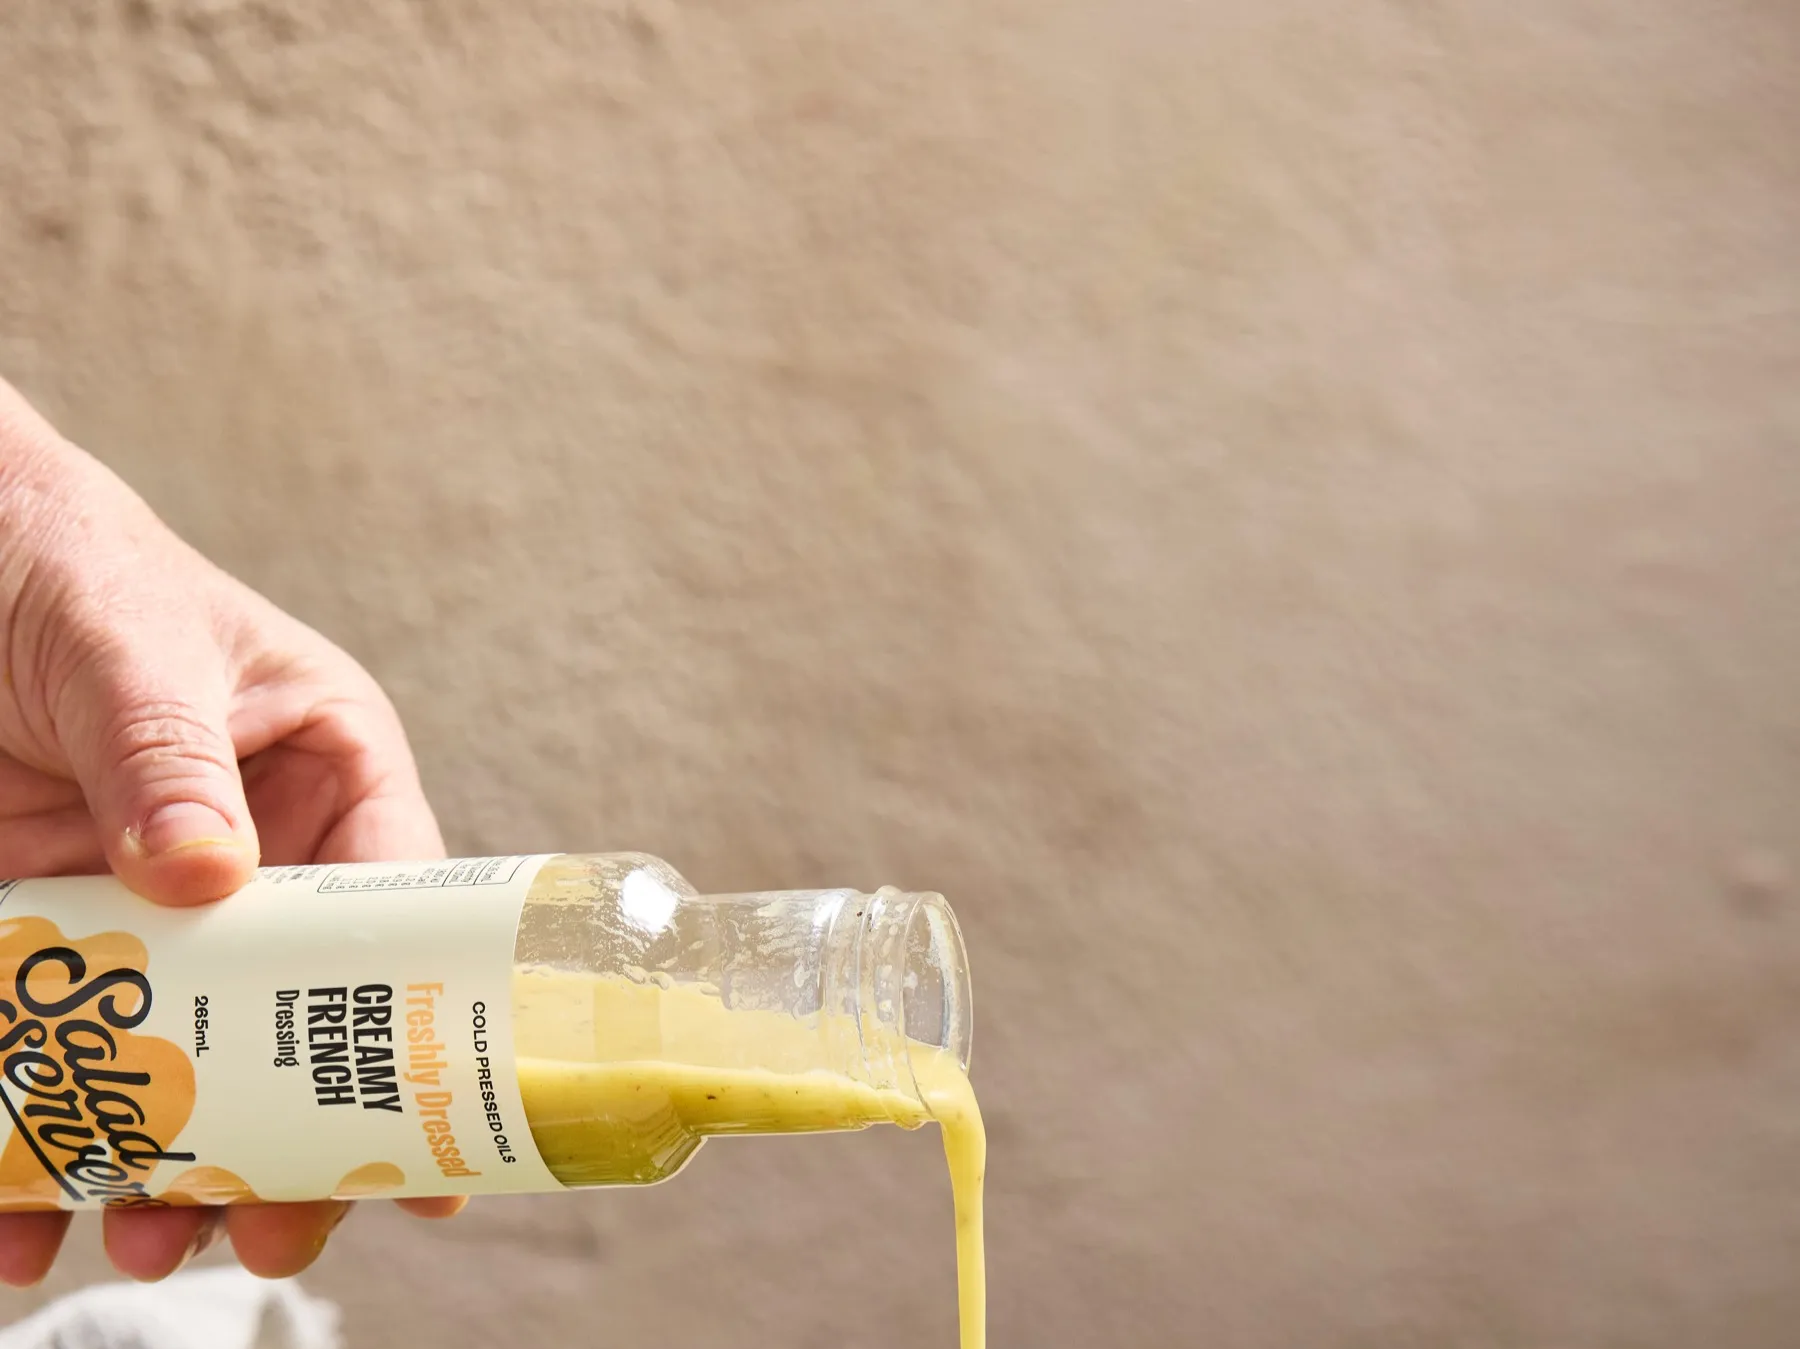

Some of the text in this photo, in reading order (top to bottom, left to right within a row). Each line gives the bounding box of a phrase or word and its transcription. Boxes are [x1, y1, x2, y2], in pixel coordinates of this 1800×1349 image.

[15, 946, 196, 1170] Salad
[194, 995, 209, 1058] 265mL
[273, 989, 300, 1068] Dressing
[307, 986, 357, 1106] FRENCH
[352, 983, 404, 1113] CREAMY
[403, 982, 482, 1178] Freshly Dressed
[472, 1001, 516, 1164] COLD PRESSED OILS
